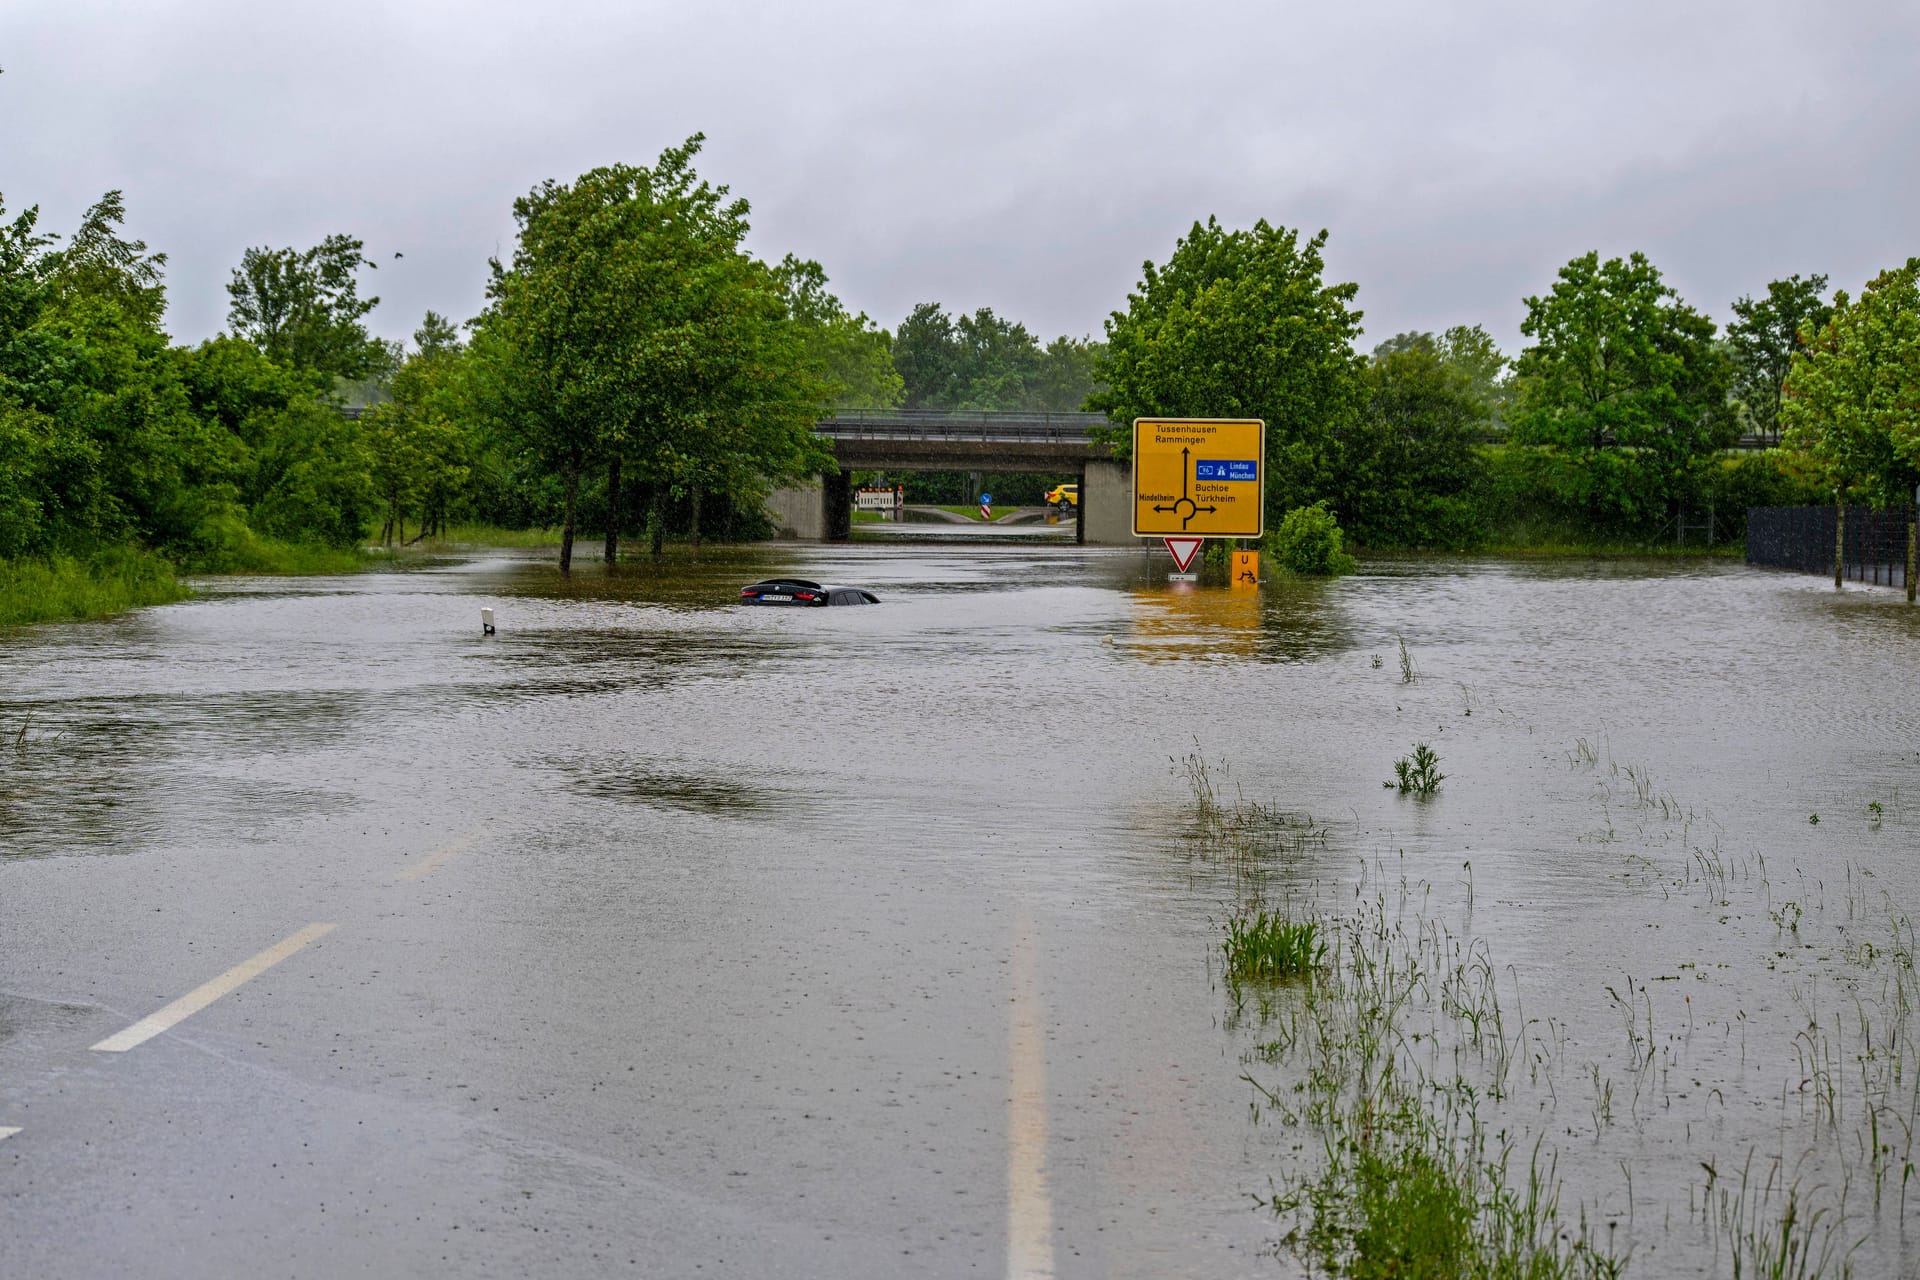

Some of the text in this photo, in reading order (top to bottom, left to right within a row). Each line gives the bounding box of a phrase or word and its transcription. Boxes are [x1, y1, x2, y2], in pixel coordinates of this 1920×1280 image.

[1156, 425, 1217, 433] Tussenhausen
[1155, 435, 1206, 445] Rammingen
[1229, 462, 1249, 470] Lindau
[1229, 471, 1255, 479] München
[1195, 483, 1229, 492] Buchloe
[1195, 494, 1236, 502] Türkheim
[1241, 555, 1249, 564] U
